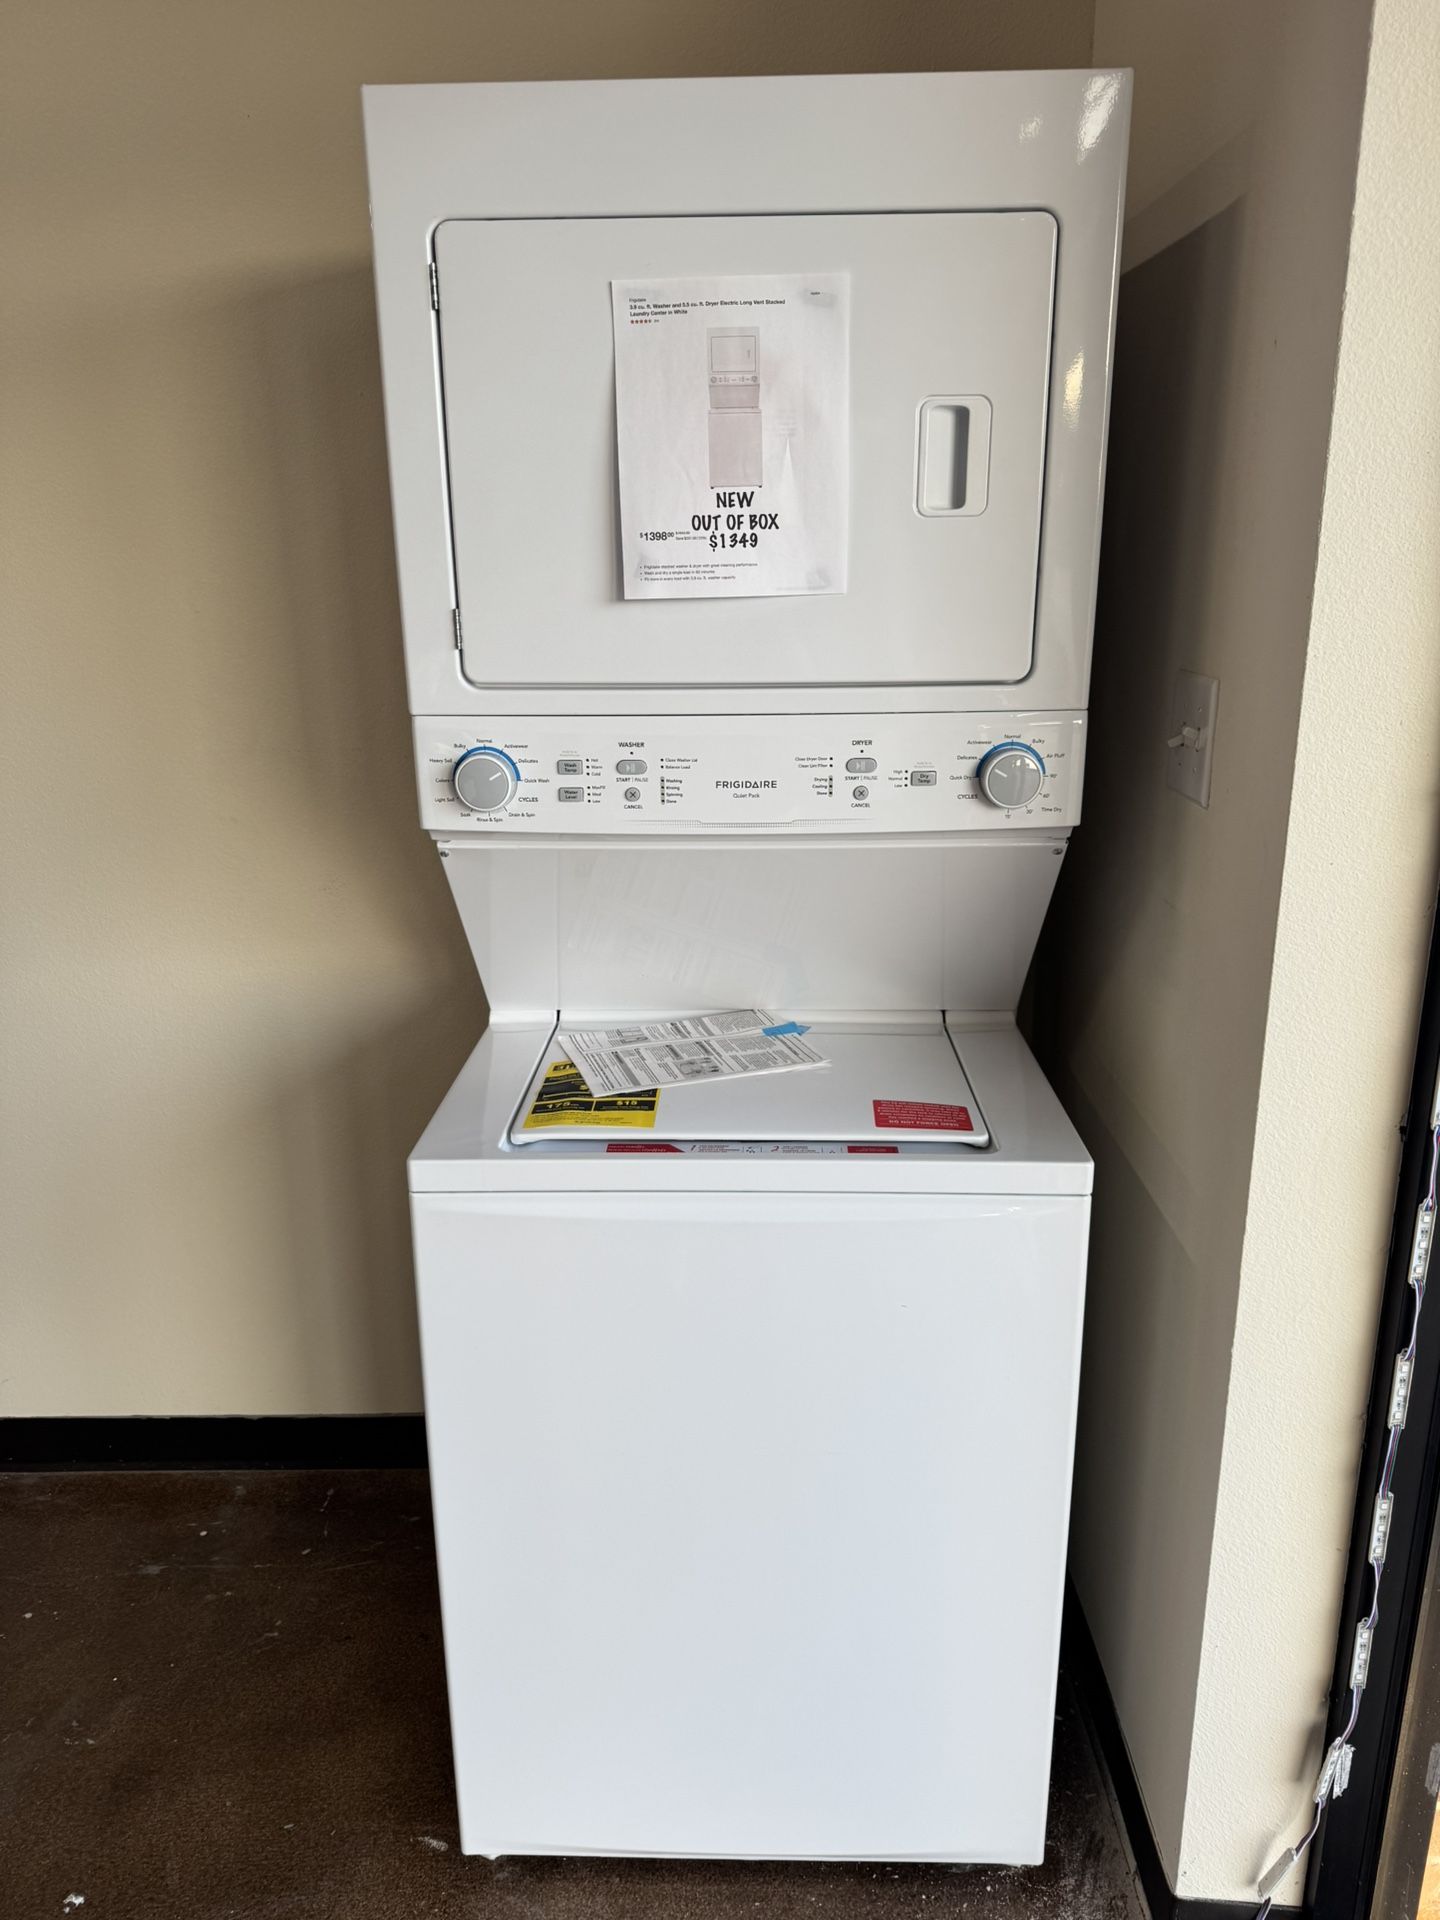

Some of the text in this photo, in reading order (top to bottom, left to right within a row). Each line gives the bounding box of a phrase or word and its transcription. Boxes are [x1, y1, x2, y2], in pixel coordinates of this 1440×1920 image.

[716, 491, 755, 508] NEW
[692, 513, 780, 531] OUT OF BOX
[709, 531, 758, 552] $1349
